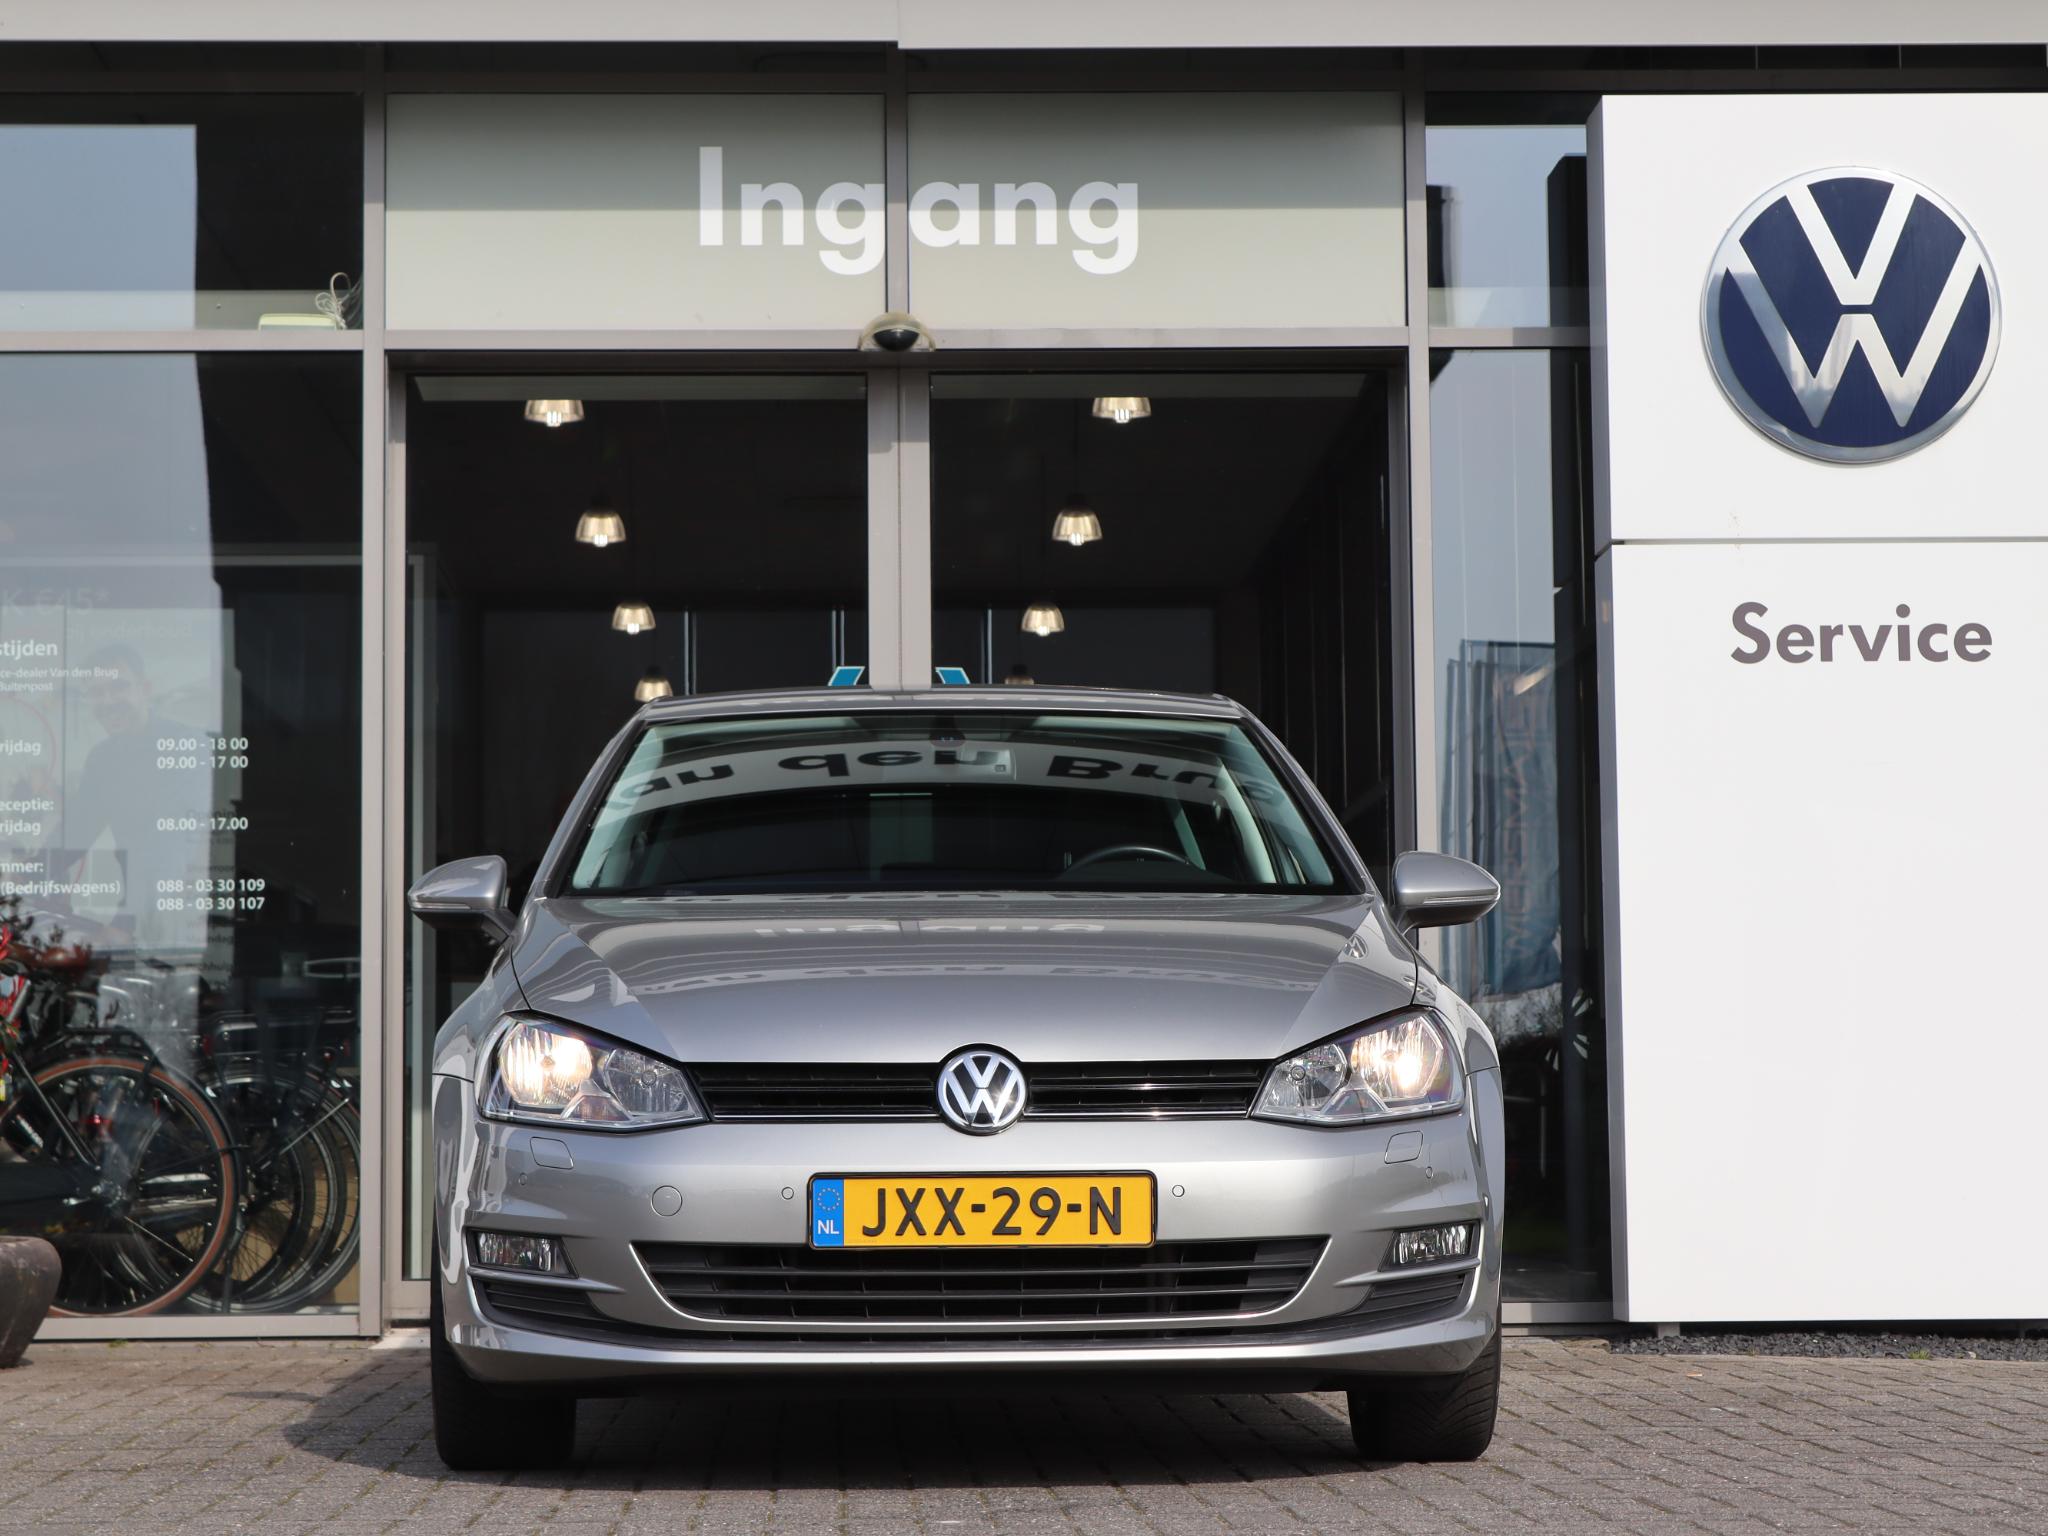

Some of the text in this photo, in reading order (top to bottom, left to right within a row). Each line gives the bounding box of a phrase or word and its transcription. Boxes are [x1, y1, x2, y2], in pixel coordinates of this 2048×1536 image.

[699, 146, 1139, 276] Ingang
[1730, 601, 1992, 664] Service
[49, 667, 69, 679] Van
[71, 667, 92, 678] den
[94, 667, 119, 680] Brug
[157, 738, 197, 751] 09.00
[157, 756, 197, 769] 09.00
[157, 818, 197, 831] 08.00
[210, 817, 249, 831] 17.00
[1, 880, 121, 897] (Bedrijfswagens)
[157, 880, 184, 893] 088
[196, 880, 214, 893] 03
[217, 879, 236, 893] 30
[239, 878, 266, 892] 109
[157, 898, 184, 911] 088
[196, 898, 214, 911] 03
[217, 897, 236, 911] 30
[239, 896, 266, 910] 107
[940, 1051, 1024, 1128] VW
[862, 1186, 1122, 1237] JXX-29-N
[817, 1219, 840, 1235] NL
